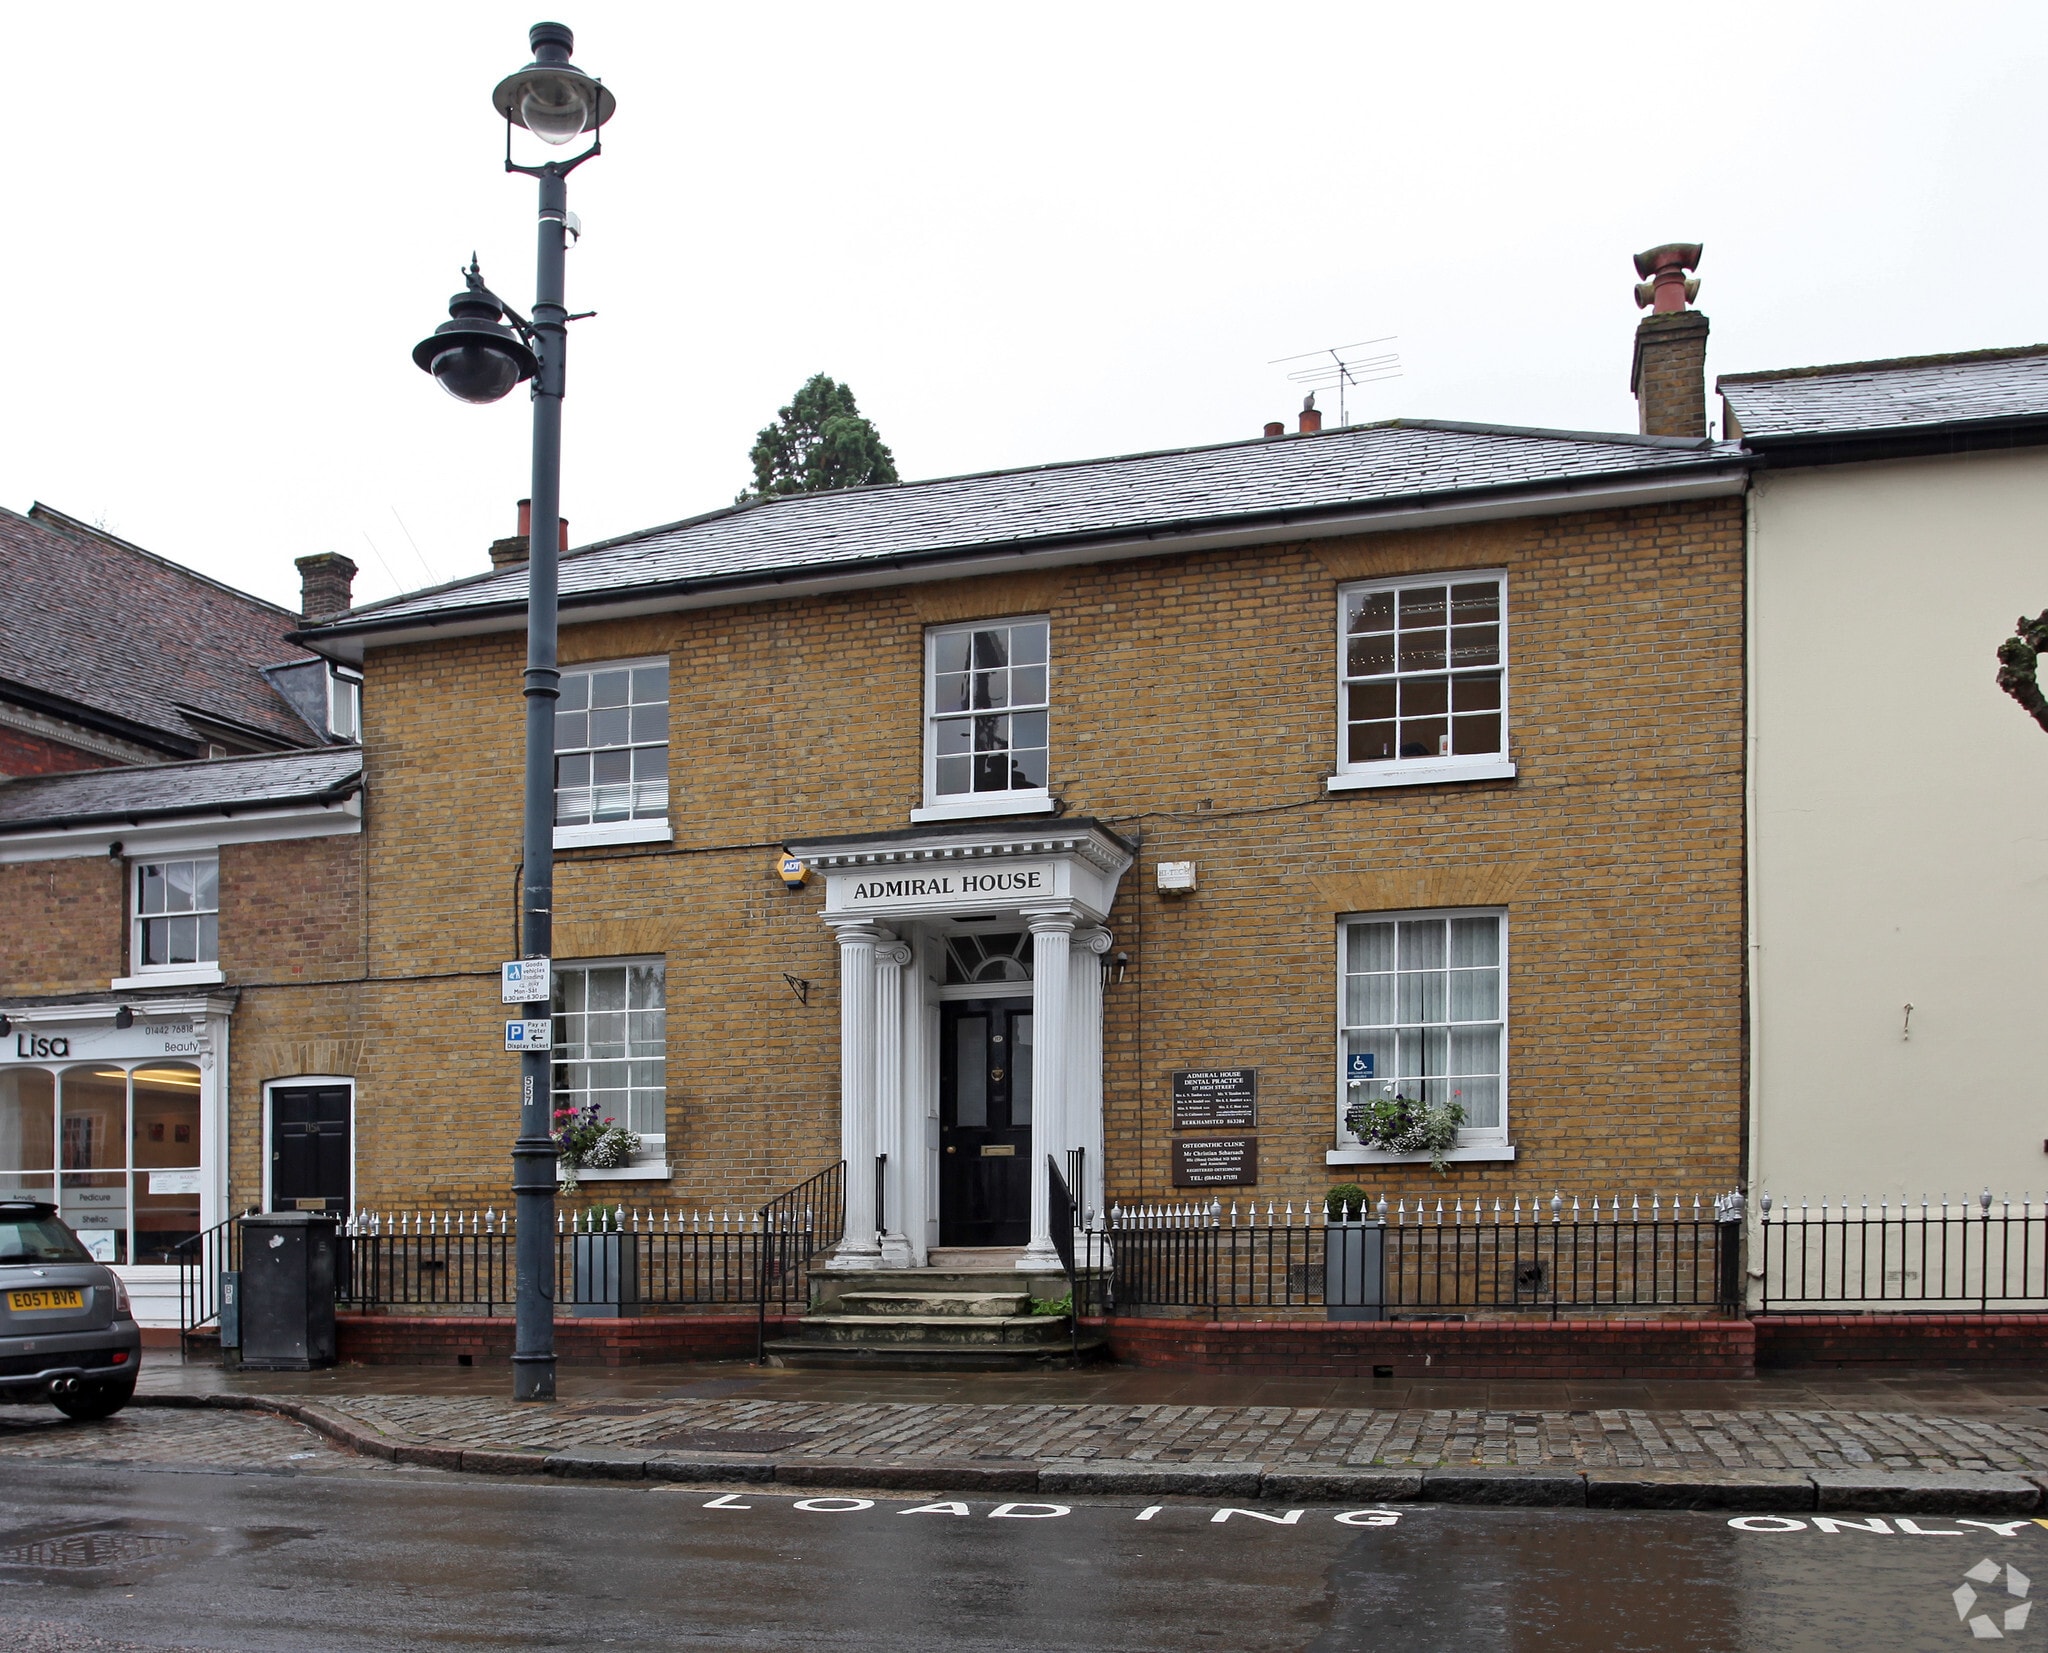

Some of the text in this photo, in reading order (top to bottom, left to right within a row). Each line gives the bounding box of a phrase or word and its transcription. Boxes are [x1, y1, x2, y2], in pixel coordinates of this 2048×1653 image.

[784, 861, 800, 872] ADT
[854, 872, 1041, 899] ADMIRAL HOUSE
[145, 1025, 169, 1035] 01442
[511, 1026, 521, 1040] P
[17, 1033, 70, 1057] Lisa
[165, 1041, 199, 1053] Beauty
[79, 1193, 111, 1201] Pedicure
[82, 1215, 108, 1223] Shellac
[51, 1290, 78, 1306] BVR
[702, 1494, 2033, 1536] LOADING ONLY
